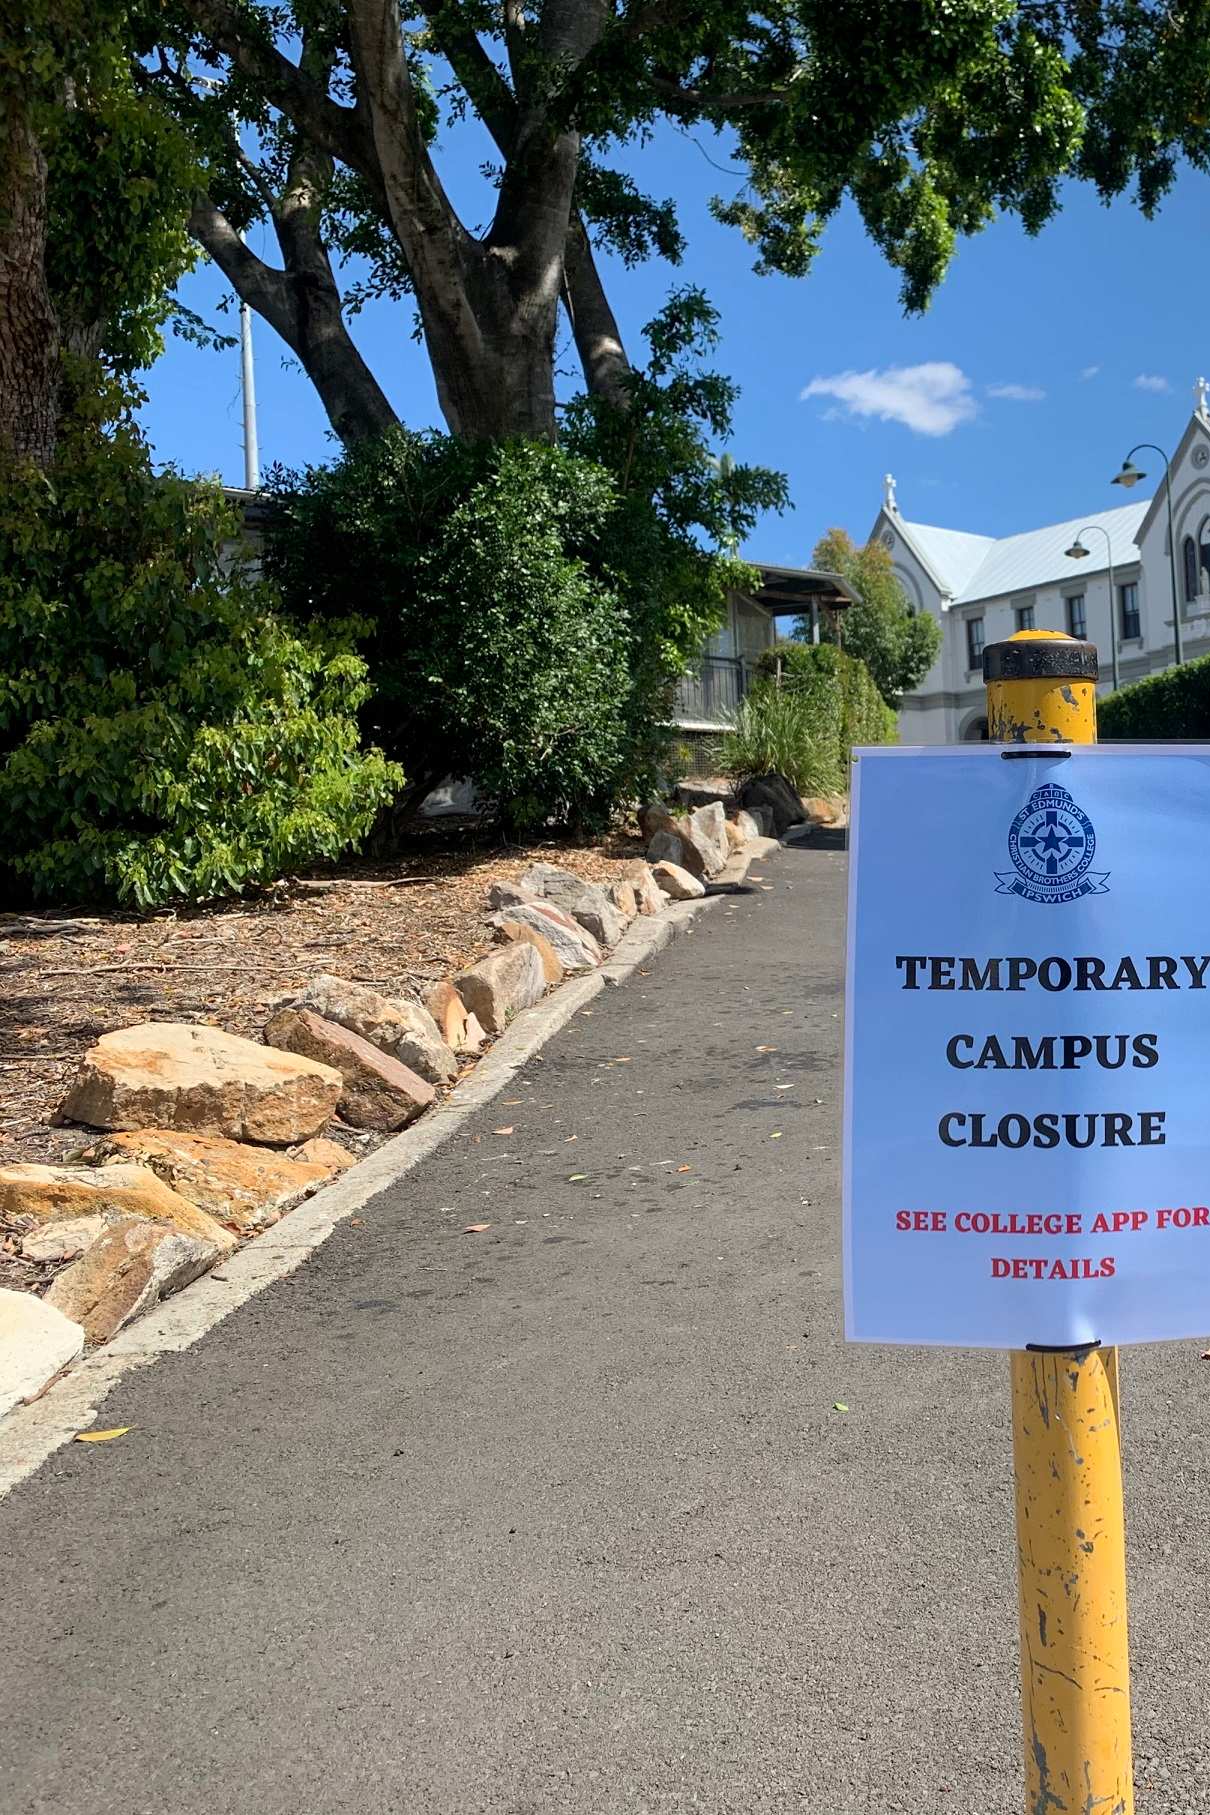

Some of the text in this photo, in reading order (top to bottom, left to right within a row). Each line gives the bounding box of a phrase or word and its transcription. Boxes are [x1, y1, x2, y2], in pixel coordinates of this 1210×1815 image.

[1020, 799, 1085, 821] ST EDMUND'S
[1009, 833, 1095, 885] CHRISTIAN BROTHERS COLLEGE
[1021, 888, 1083, 903] IPSWICH
[946, 1032, 1160, 1072] CAMPUS
[937, 1111, 1166, 1150] CLOSURE
[895, 1206, 1210, 1236] SEE COLLEGE APP FOR
[990, 1256, 1116, 1281] DETAILS
